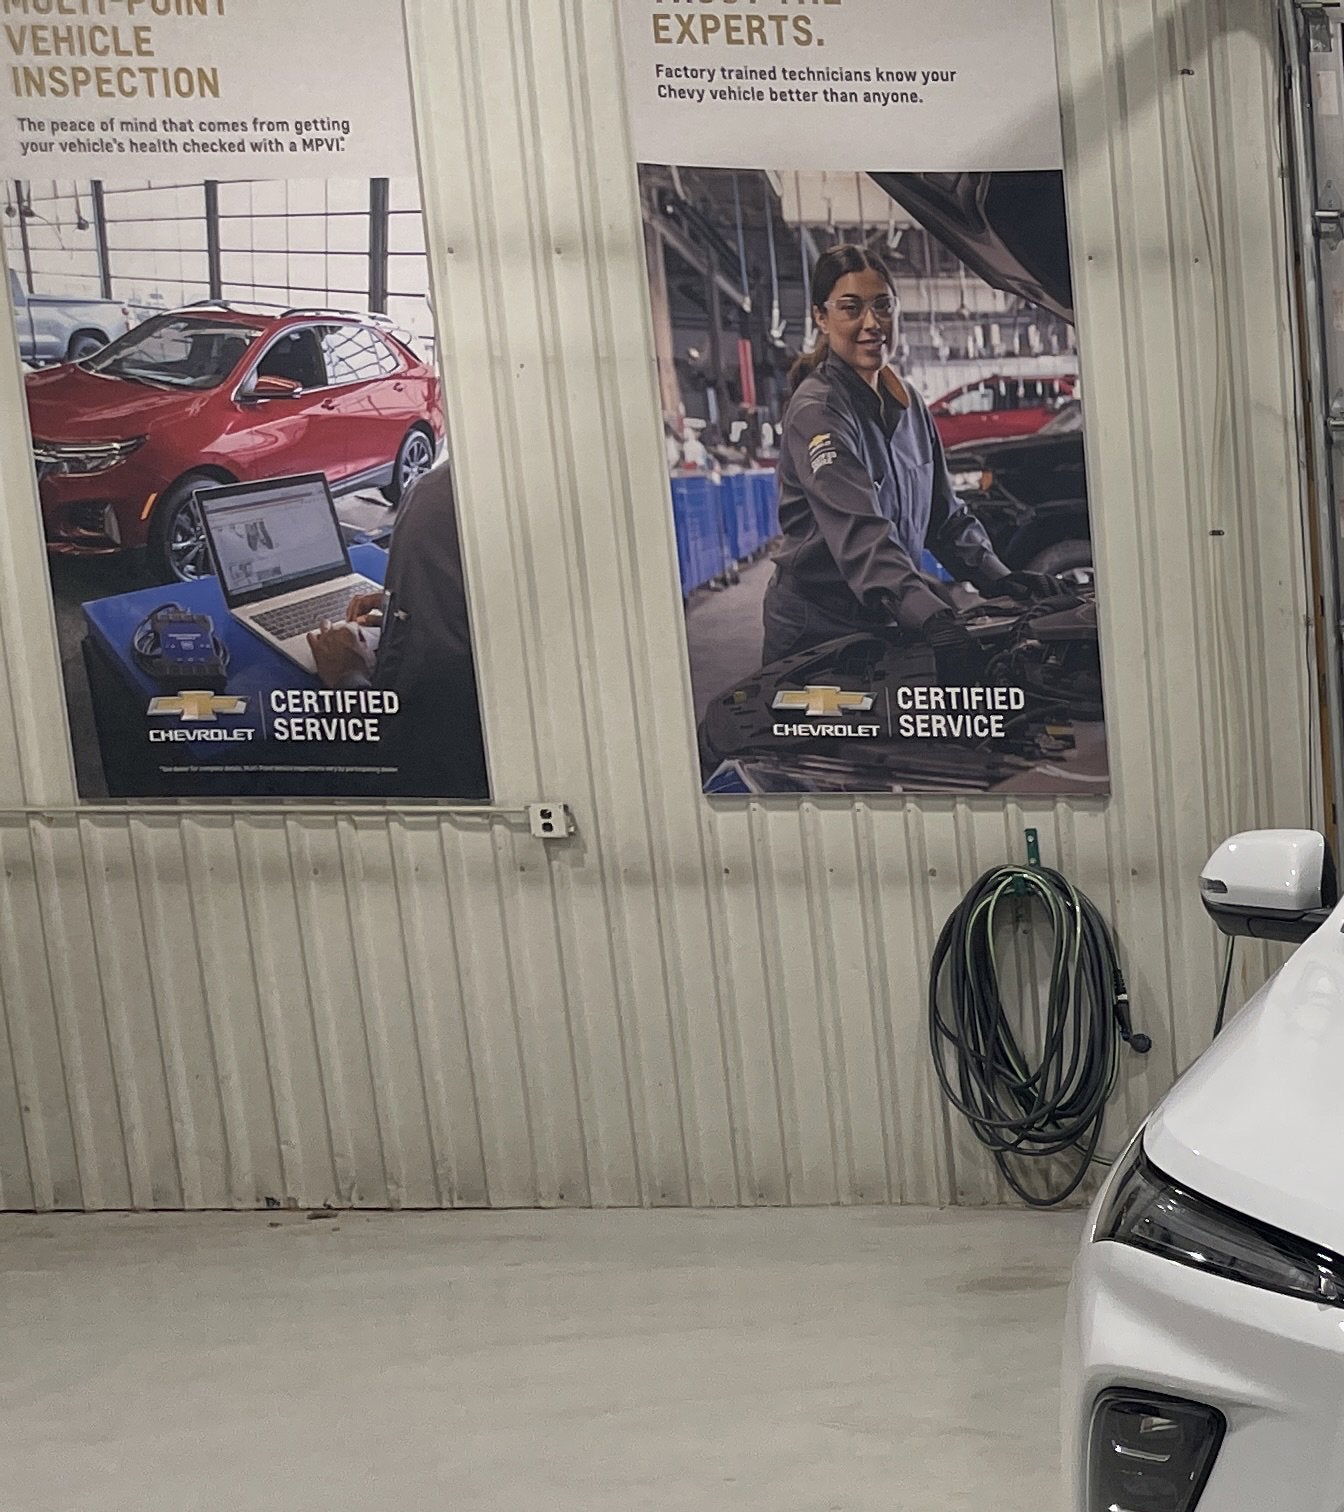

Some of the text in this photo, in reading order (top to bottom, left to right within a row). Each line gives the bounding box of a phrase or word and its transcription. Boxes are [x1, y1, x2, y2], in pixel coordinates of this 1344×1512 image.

[4, 24, 155, 57] VEHICLE
[652, 13, 825, 46] EXPERTS.
[11, 66, 221, 98] INSPECTION
[655, 63, 957, 85] Factory trained technicians know your
[657, 84, 924, 106] Chevy vehicle better than anyone.
[17, 116, 350, 136] The peace of mind that comes from getting
[20, 141, 54, 157] your
[59, 137, 125, 153] vehicle's
[129, 137, 178, 153] health
[182, 138, 246, 152] checked
[250, 138, 284, 152] with
[289, 141, 297, 152] a
[270, 689, 400, 715] CERTIFIED
[897, 686, 1025, 711] CERTIFIED
[149, 728, 255, 743] CHEVROLET
[273, 718, 381, 742] SERVICE
[772, 723, 880, 738] CHEVROLET
[899, 714, 1006, 739] SERVICE
